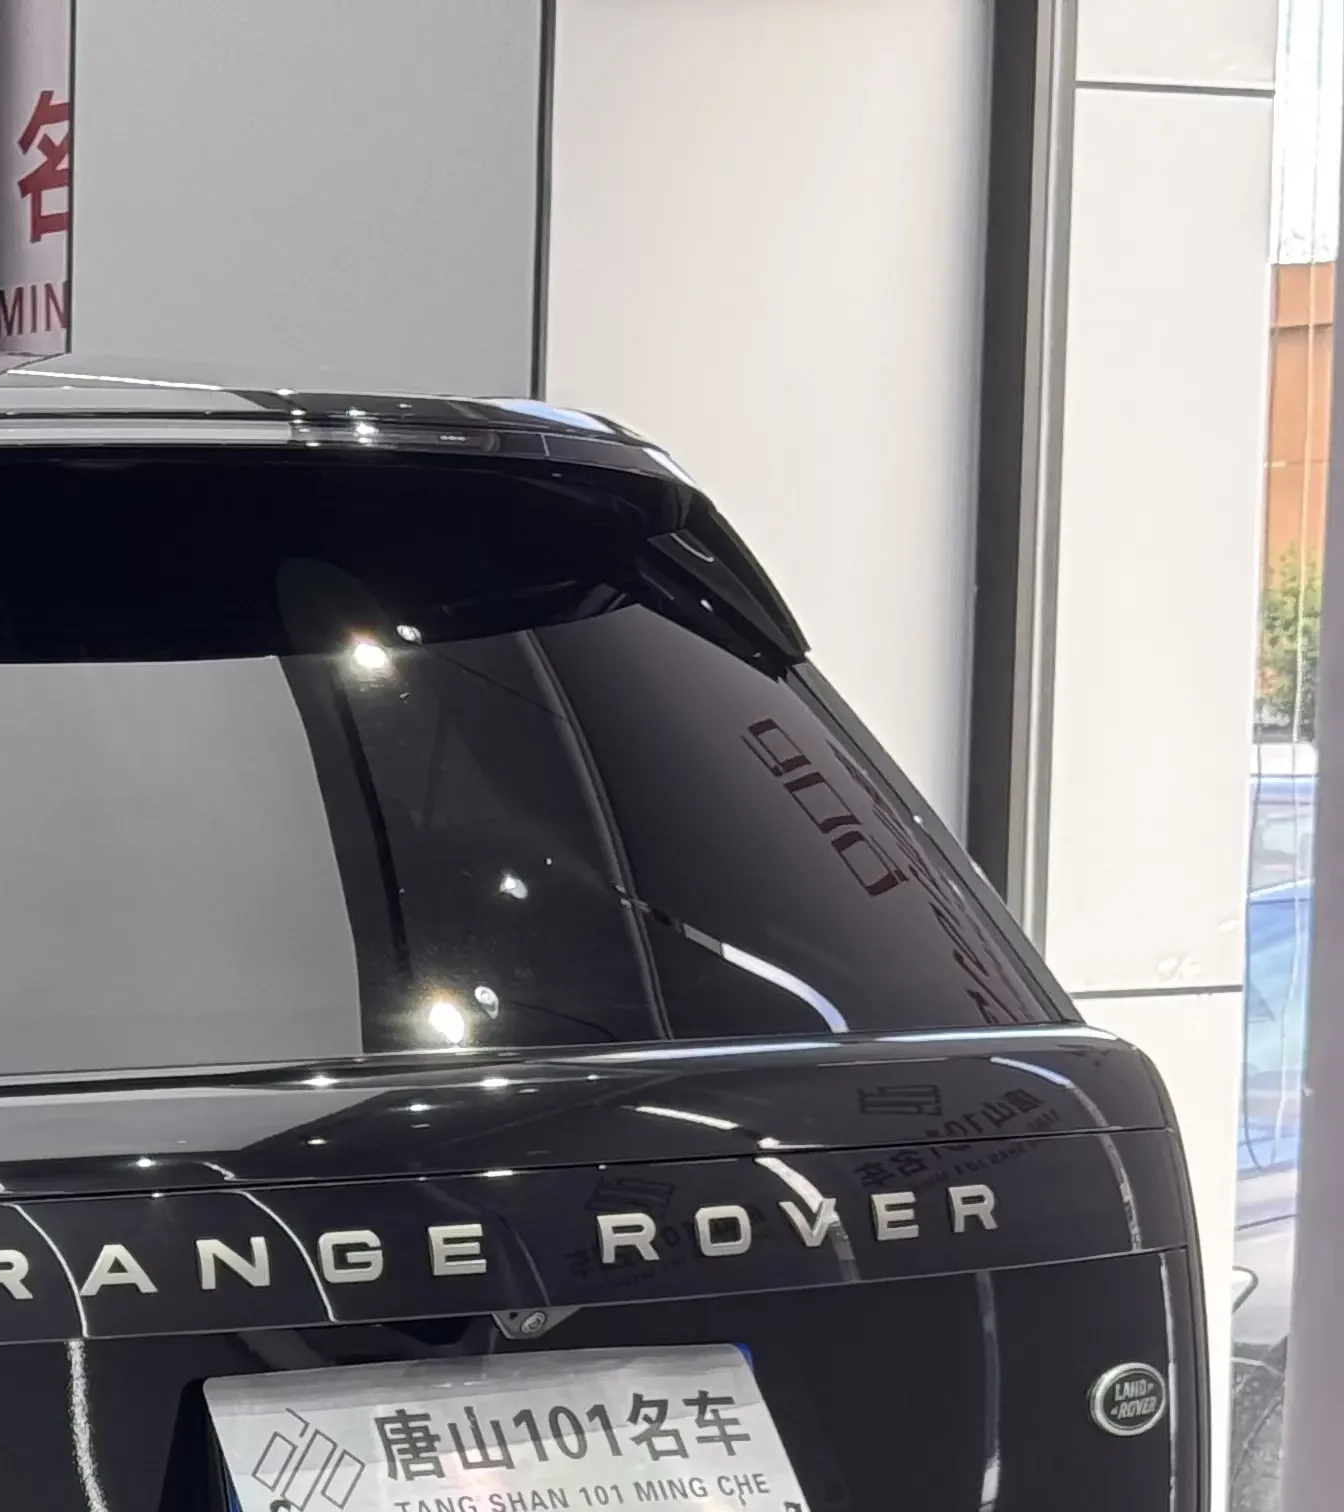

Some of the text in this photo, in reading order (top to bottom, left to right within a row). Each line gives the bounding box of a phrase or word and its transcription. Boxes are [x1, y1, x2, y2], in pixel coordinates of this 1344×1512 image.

[596, 1183, 999, 1265] ROVER
[1114, 1379, 1147, 1402] LAND
[1116, 1396, 1157, 1420] ROVER
[373, 1389, 751, 1482] 唐山101名车
[579, 1483, 623, 1508] 101
[636, 1474, 709, 1503] MING
[718, 1472, 772, 1499] CHE
